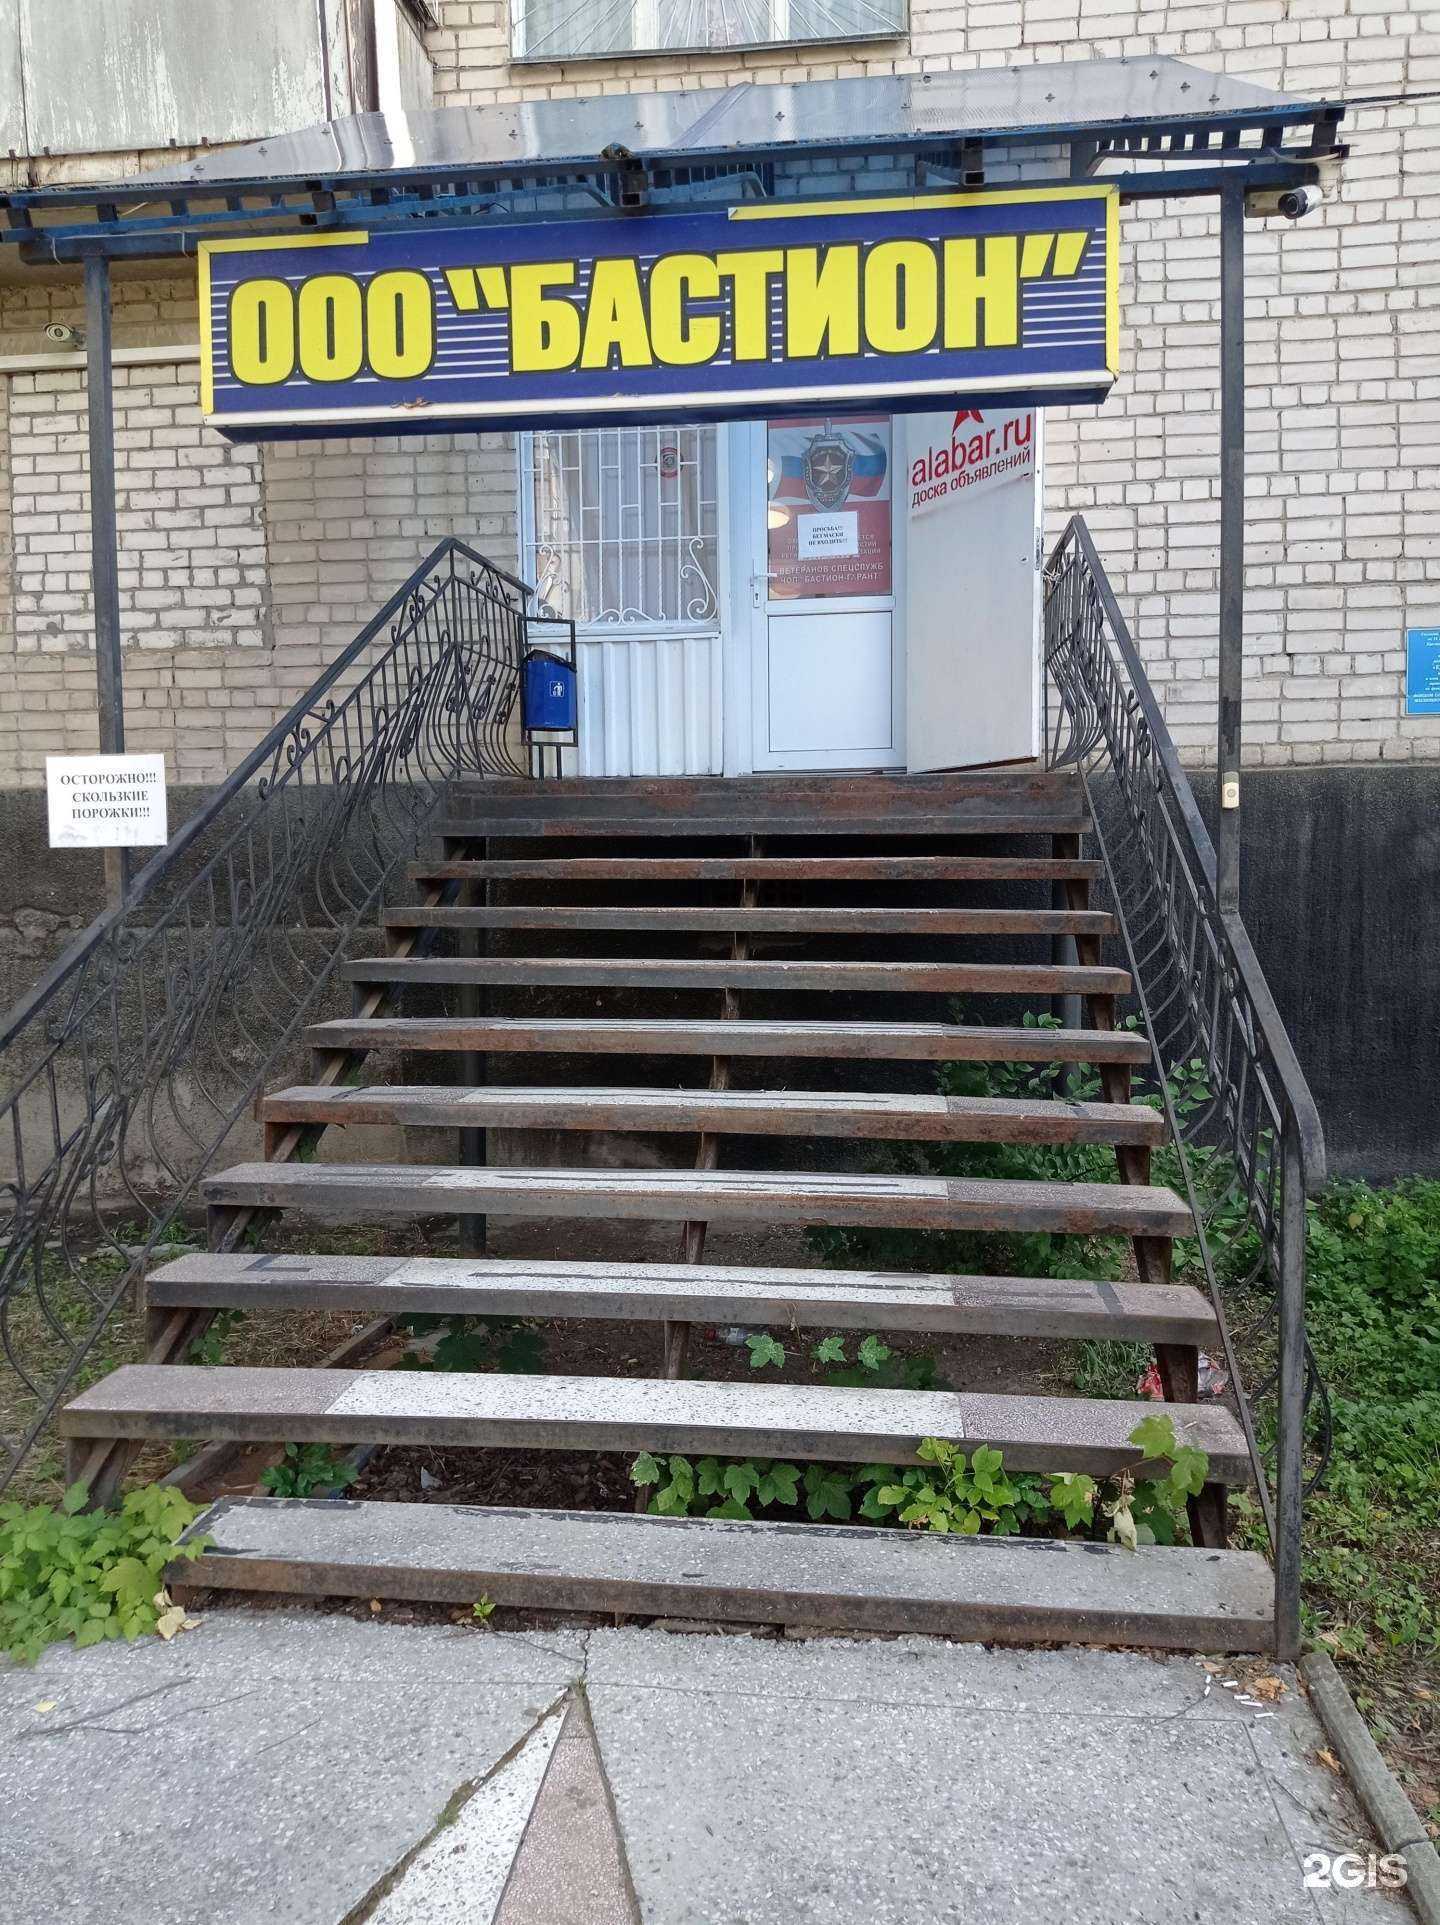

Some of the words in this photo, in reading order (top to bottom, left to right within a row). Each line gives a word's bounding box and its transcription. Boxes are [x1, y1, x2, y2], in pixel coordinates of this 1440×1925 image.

[228, 268, 437, 388] ООО
[445, 229, 1090, 374] "БАСТИОН"
[911, 414, 1032, 487] alabar.ru
[911, 481, 948, 509] доска
[950, 446, 1031, 491] объявлений
[779, 565, 829, 575] ВЕТЕРАНОВ
[831, 562, 884, 573] СПЕЦСЛУЖБ
[60, 772, 157, 786] ОСТОРОЖНО!!!
[72, 790, 149, 803] СКОЛЬЗКИЕ
[71, 807, 151, 820] ПОРОЖКИ!!!
